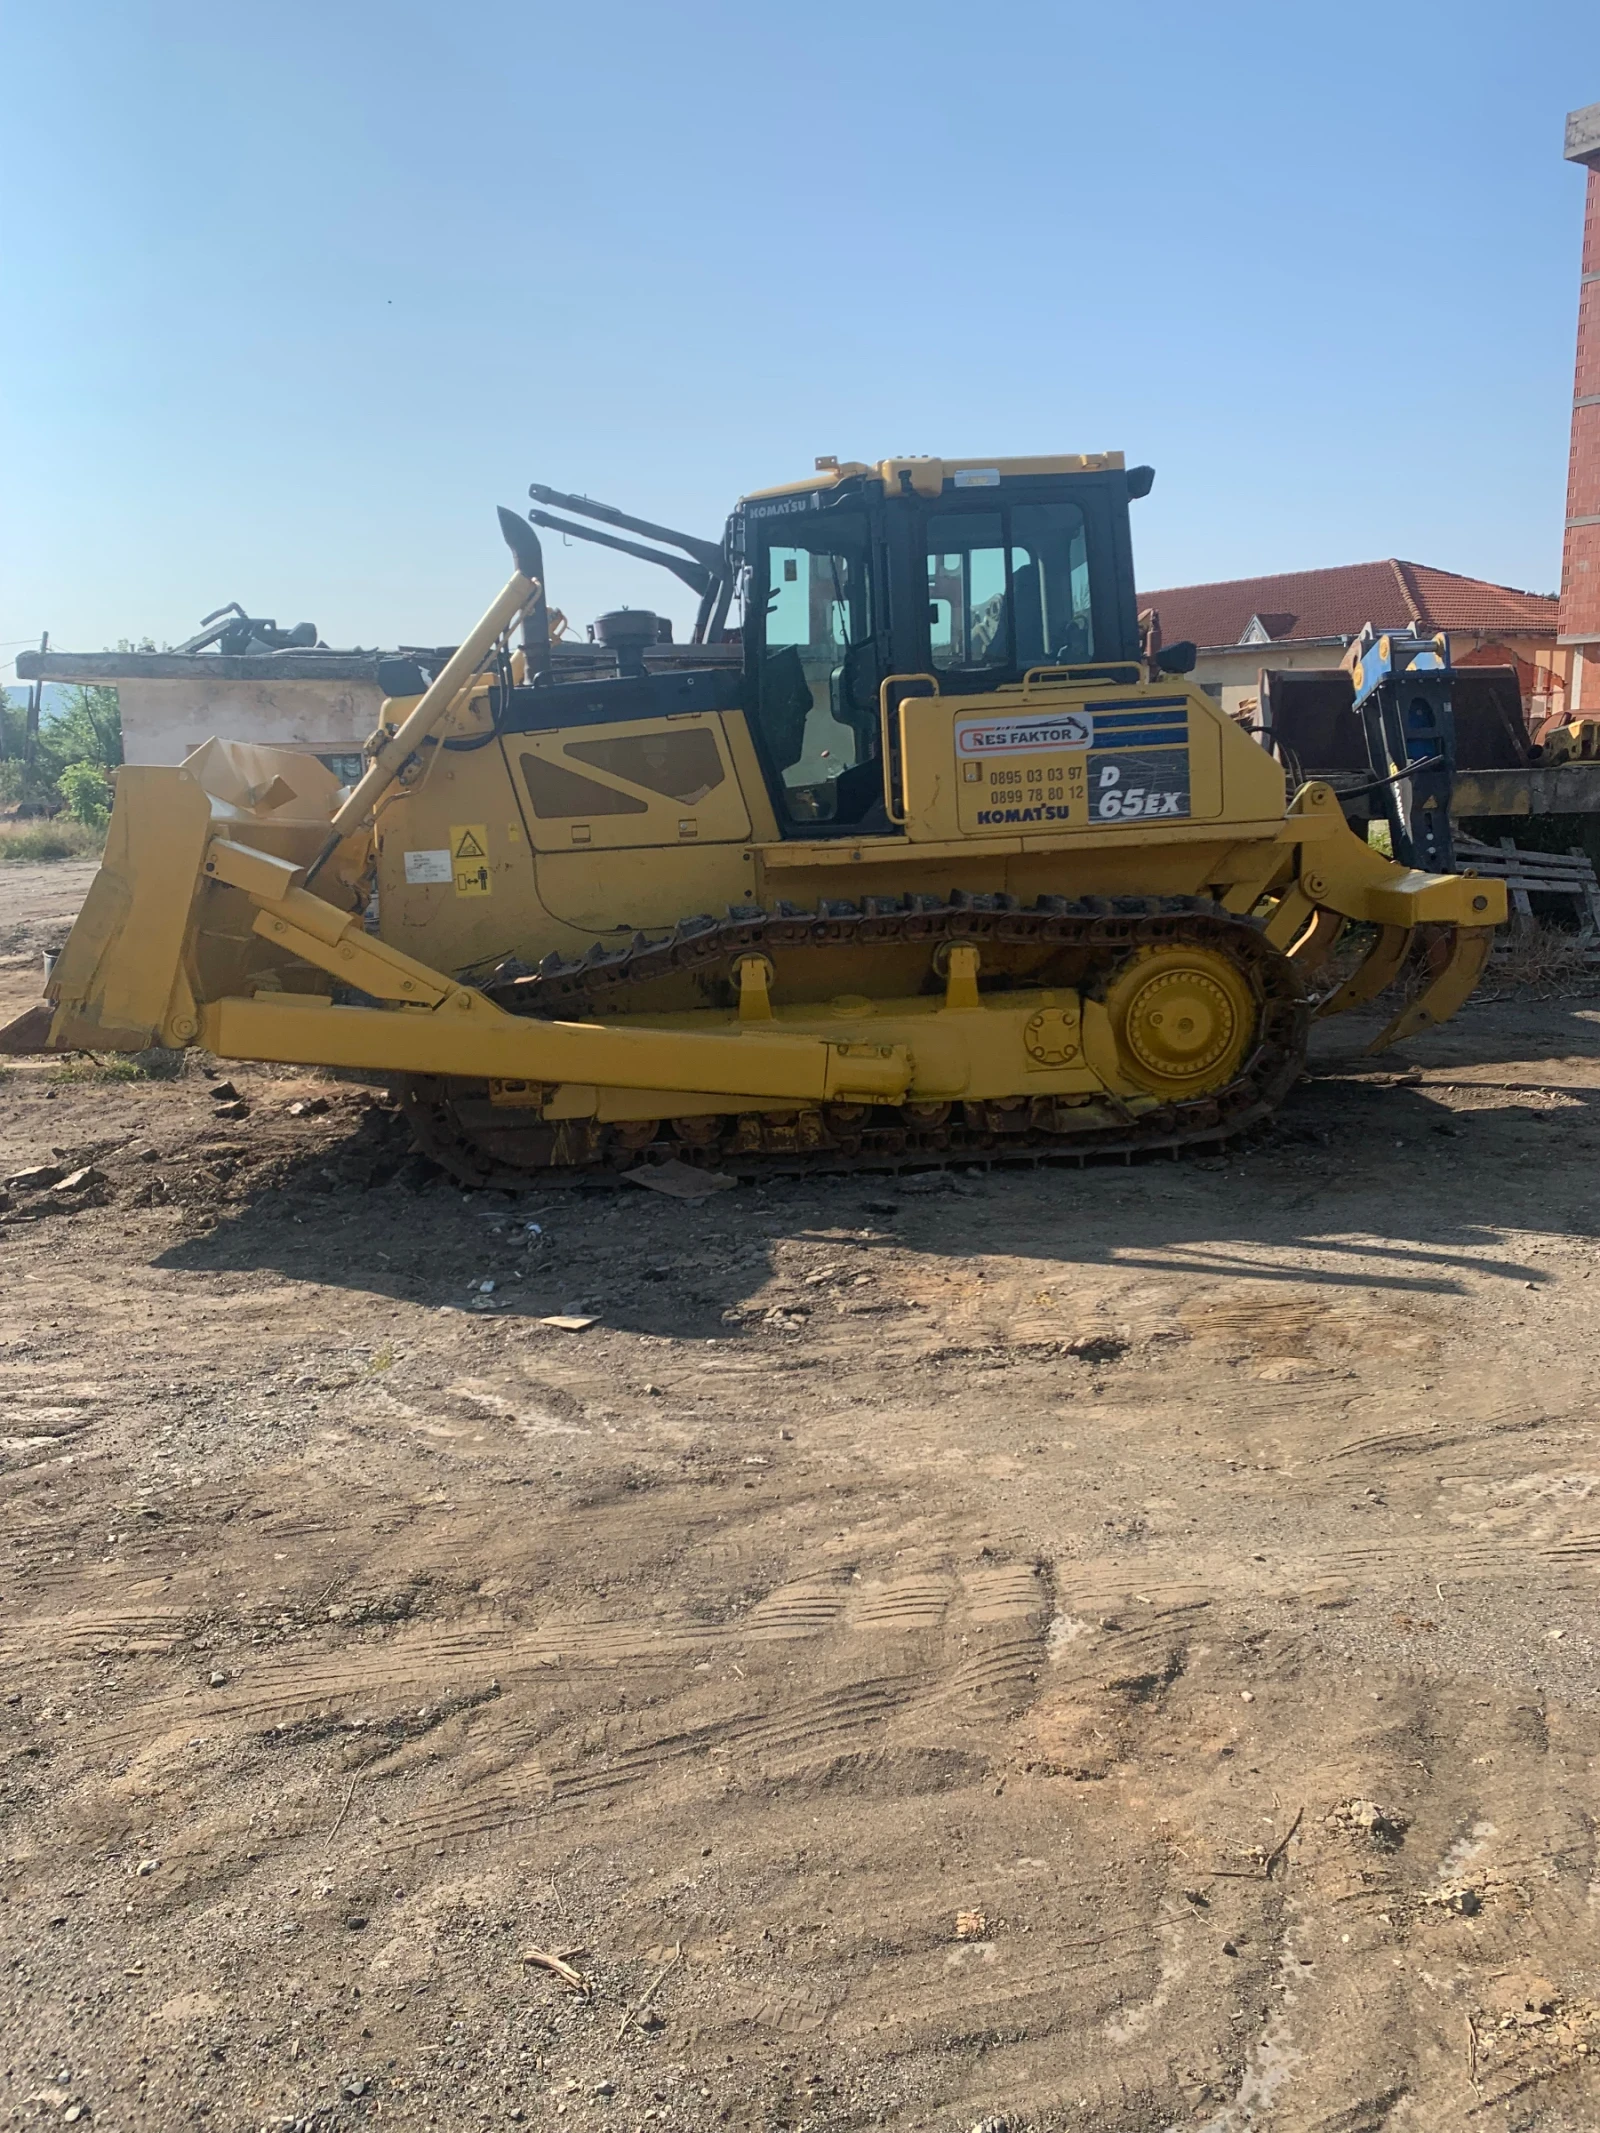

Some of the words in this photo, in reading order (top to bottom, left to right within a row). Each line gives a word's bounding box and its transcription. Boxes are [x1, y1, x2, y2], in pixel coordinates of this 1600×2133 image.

[750, 500, 806, 519] KOMATSU
[973, 732, 1006, 746] RES
[1010, 729, 1072, 744] FAKTOR
[990, 770, 1022, 785] 0895
[1027, 769, 1043, 783] 03
[1048, 767, 1064, 781] 03
[1068, 766, 1082, 780] 97
[1099, 766, 1120, 787] D
[991, 789, 1022, 804] 0899
[1028, 788, 1043, 802] 78
[1048, 786, 1064, 800] 80
[1069, 785, 1084, 799] 12
[977, 803, 1069, 824] KOMATSU
